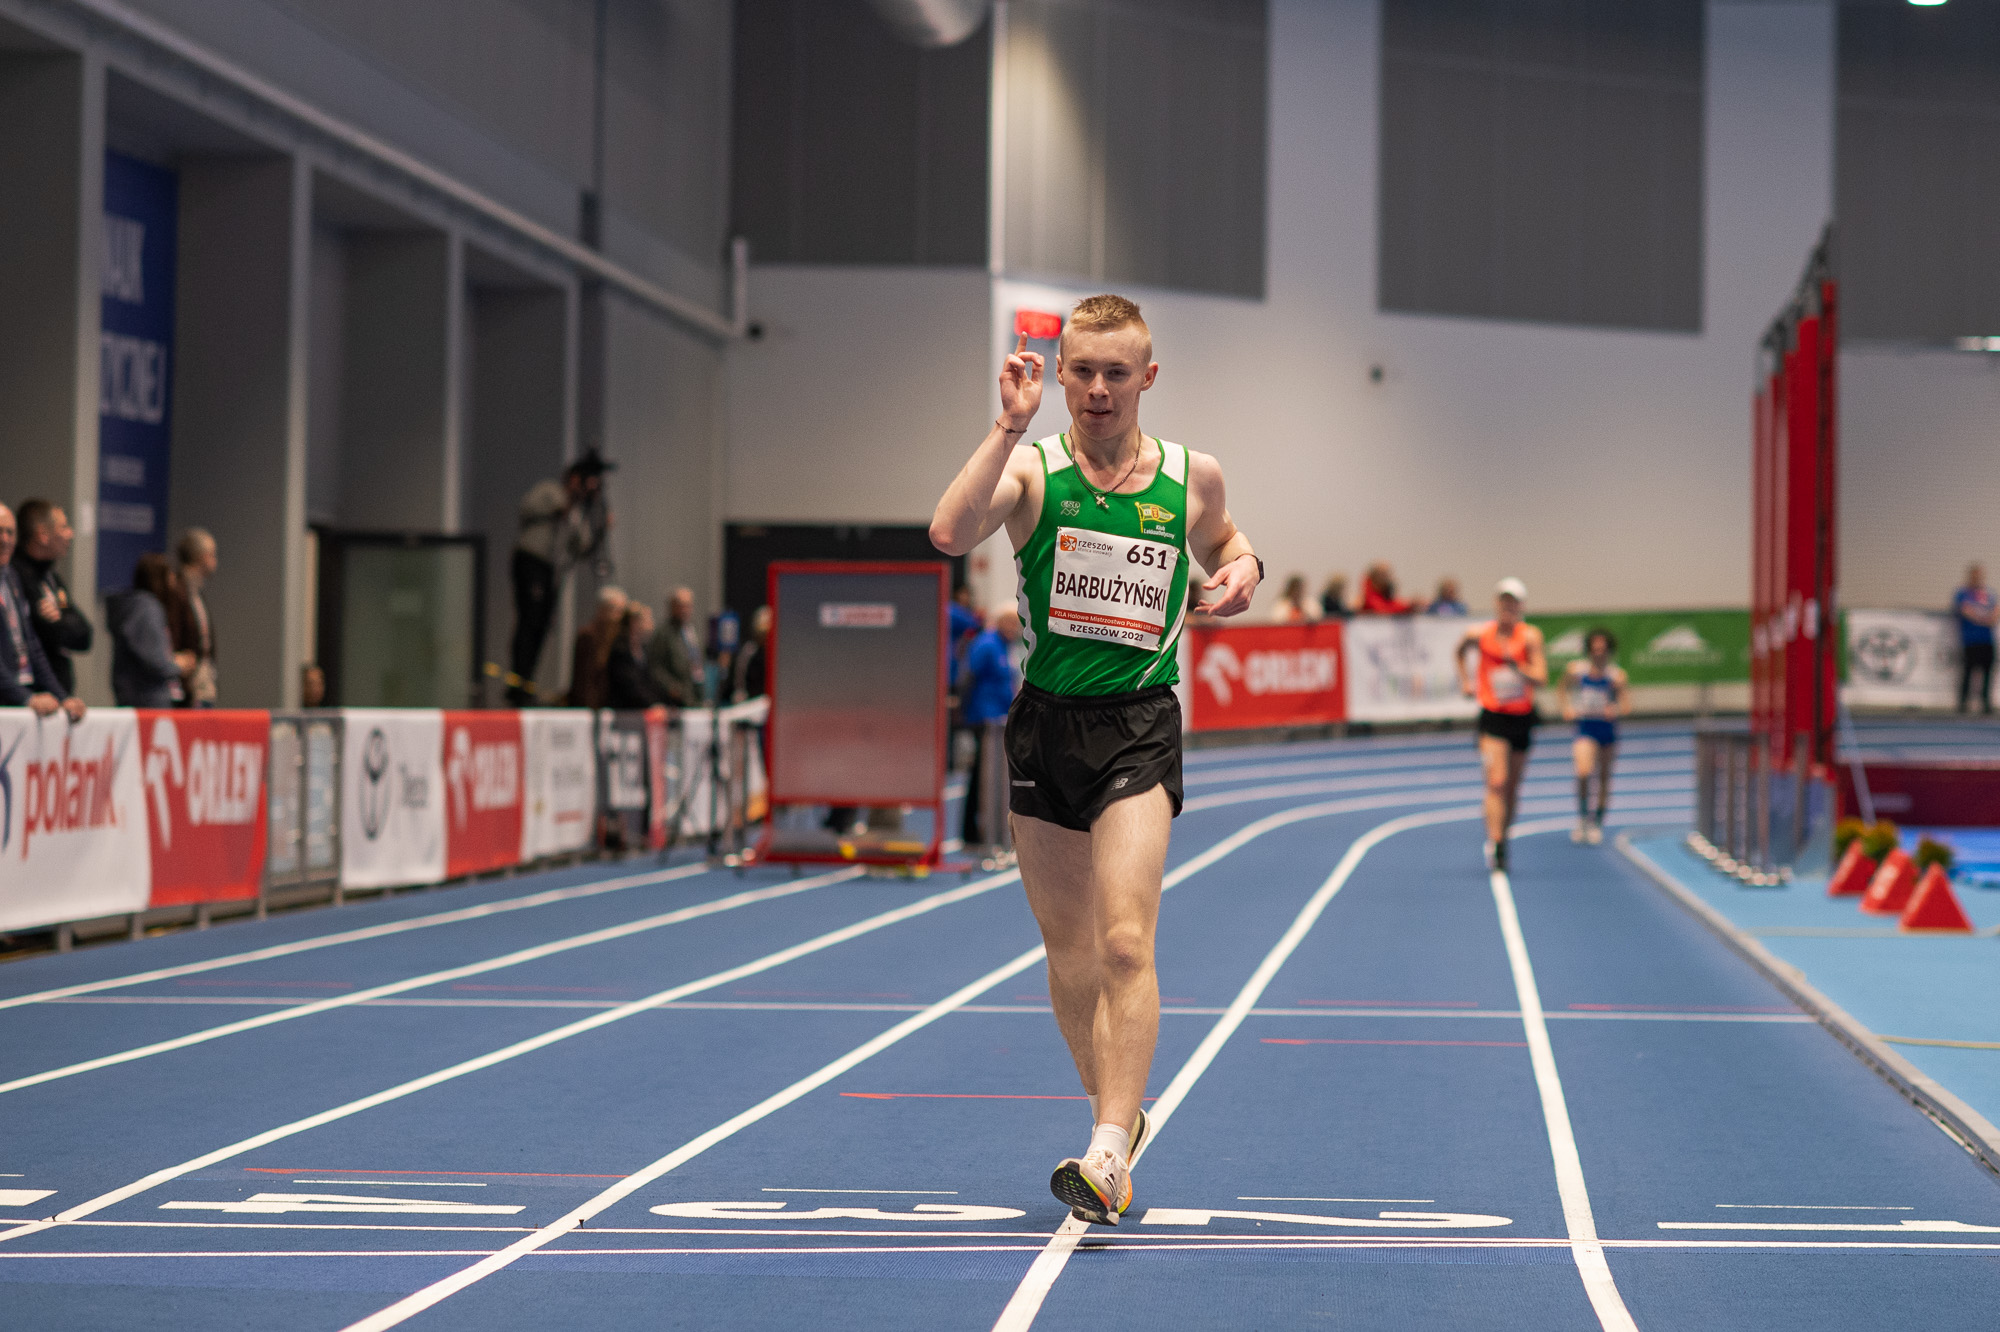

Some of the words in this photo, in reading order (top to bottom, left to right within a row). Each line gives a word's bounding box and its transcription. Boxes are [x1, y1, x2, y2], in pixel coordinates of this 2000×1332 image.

[1078, 540, 1114, 552] rzeszów
[1126, 544, 1168, 570] 651
[1055, 571, 1167, 613] BARBUŻYŃSKI
[1054, 610, 1067, 618] PZLA
[1067, 613, 1089, 621] Halowe
[1089, 616, 1126, 626] Mistrzostwa
[1126, 620, 1143, 629] Polski
[1069, 623, 1120, 638] RZESZÓW
[1121, 630, 1144, 642] 2023
[1244, 648, 1338, 696] ORLEN
[186, 738, 263, 826] ORLEN
[22, 736, 117, 860] polanik
[649, 1201, 1026, 1221] 3
[1140, 1208, 1513, 1228] 2
